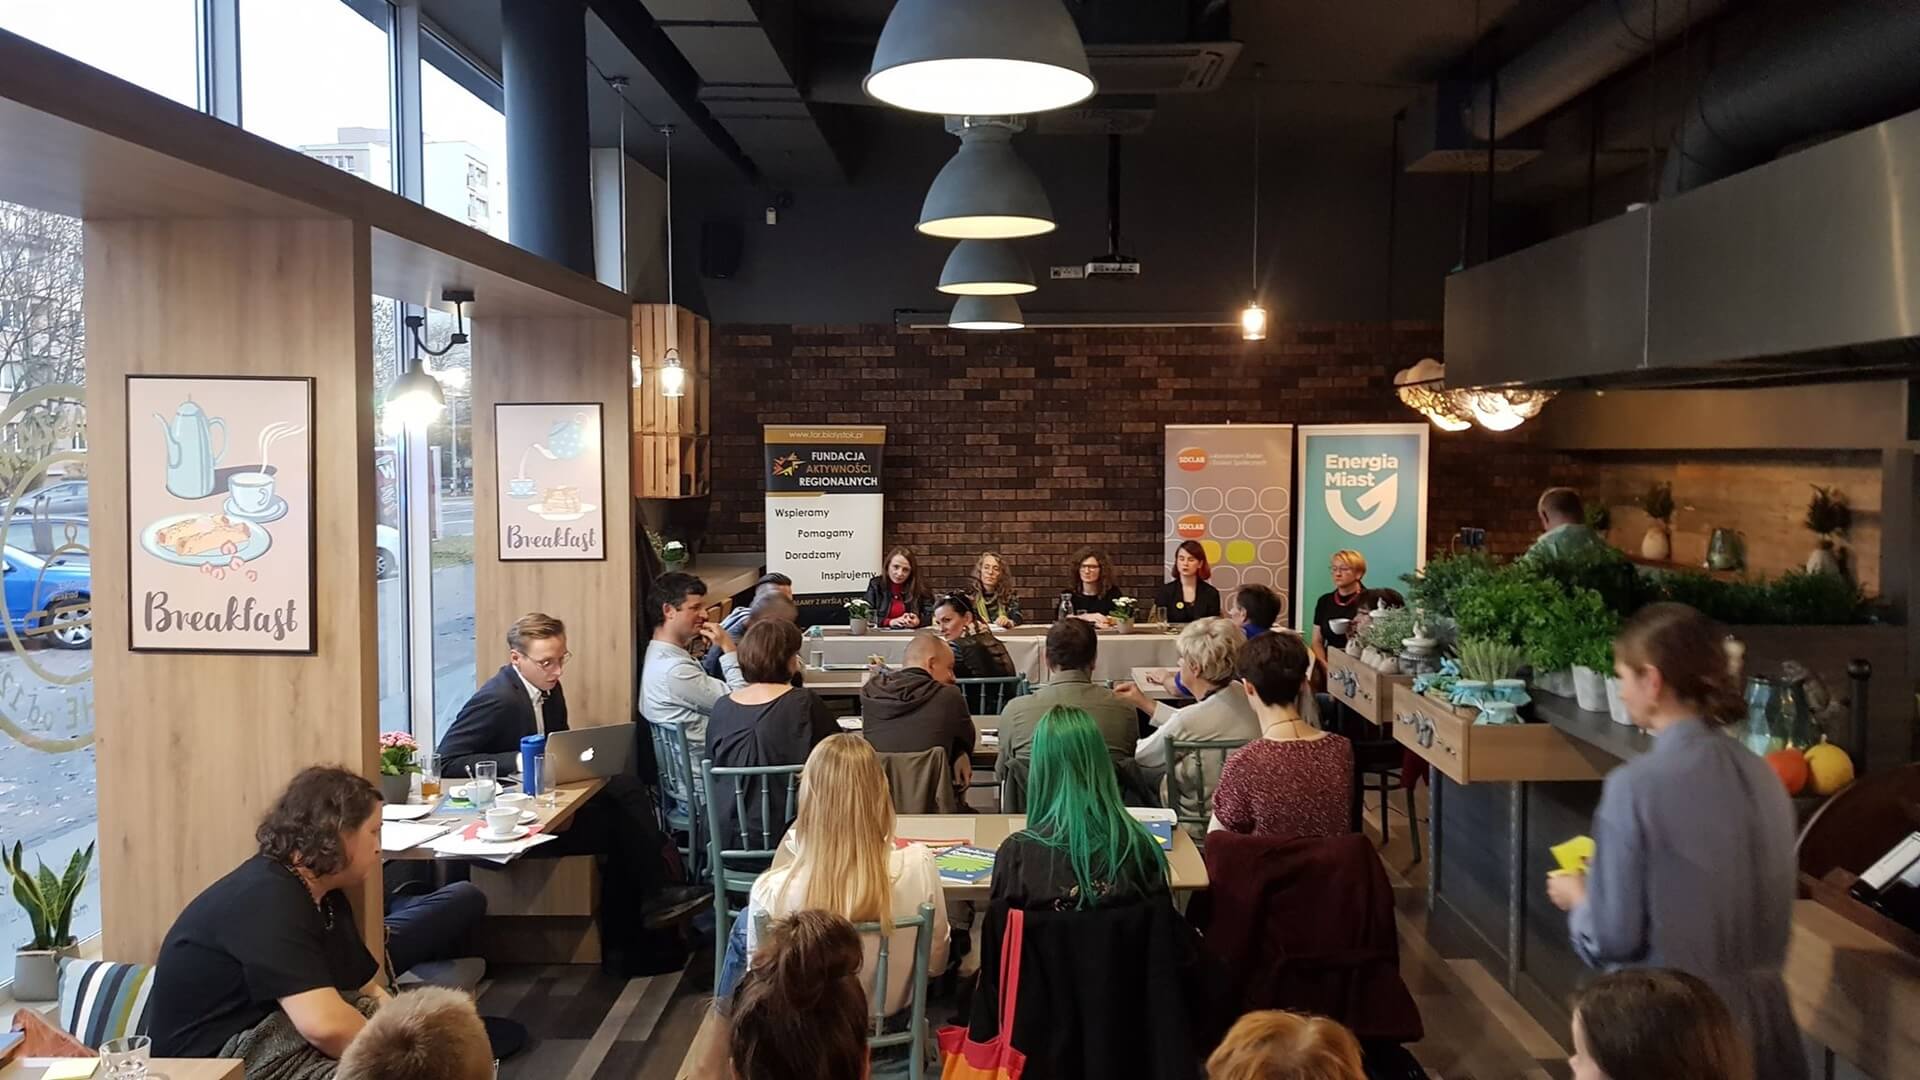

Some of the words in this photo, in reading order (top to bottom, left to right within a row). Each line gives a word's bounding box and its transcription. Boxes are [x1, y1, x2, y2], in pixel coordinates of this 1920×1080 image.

[811, 451, 866, 461] FUNDACJA
[806, 462, 871, 474] AKTYWNOŚCI
[1325, 453, 1399, 472] Energia
[799, 477, 878, 487] REGIONALNYCH
[1325, 471, 1376, 487] Miast
[775, 508, 830, 519] Wspieramy
[506, 524, 597, 552] Breakfast
[797, 529, 854, 540] Pomagamy
[785, 550, 841, 561] Doradzamy
[821, 570, 877, 581] Inspirujemy
[144, 591, 298, 642] Breakfast
